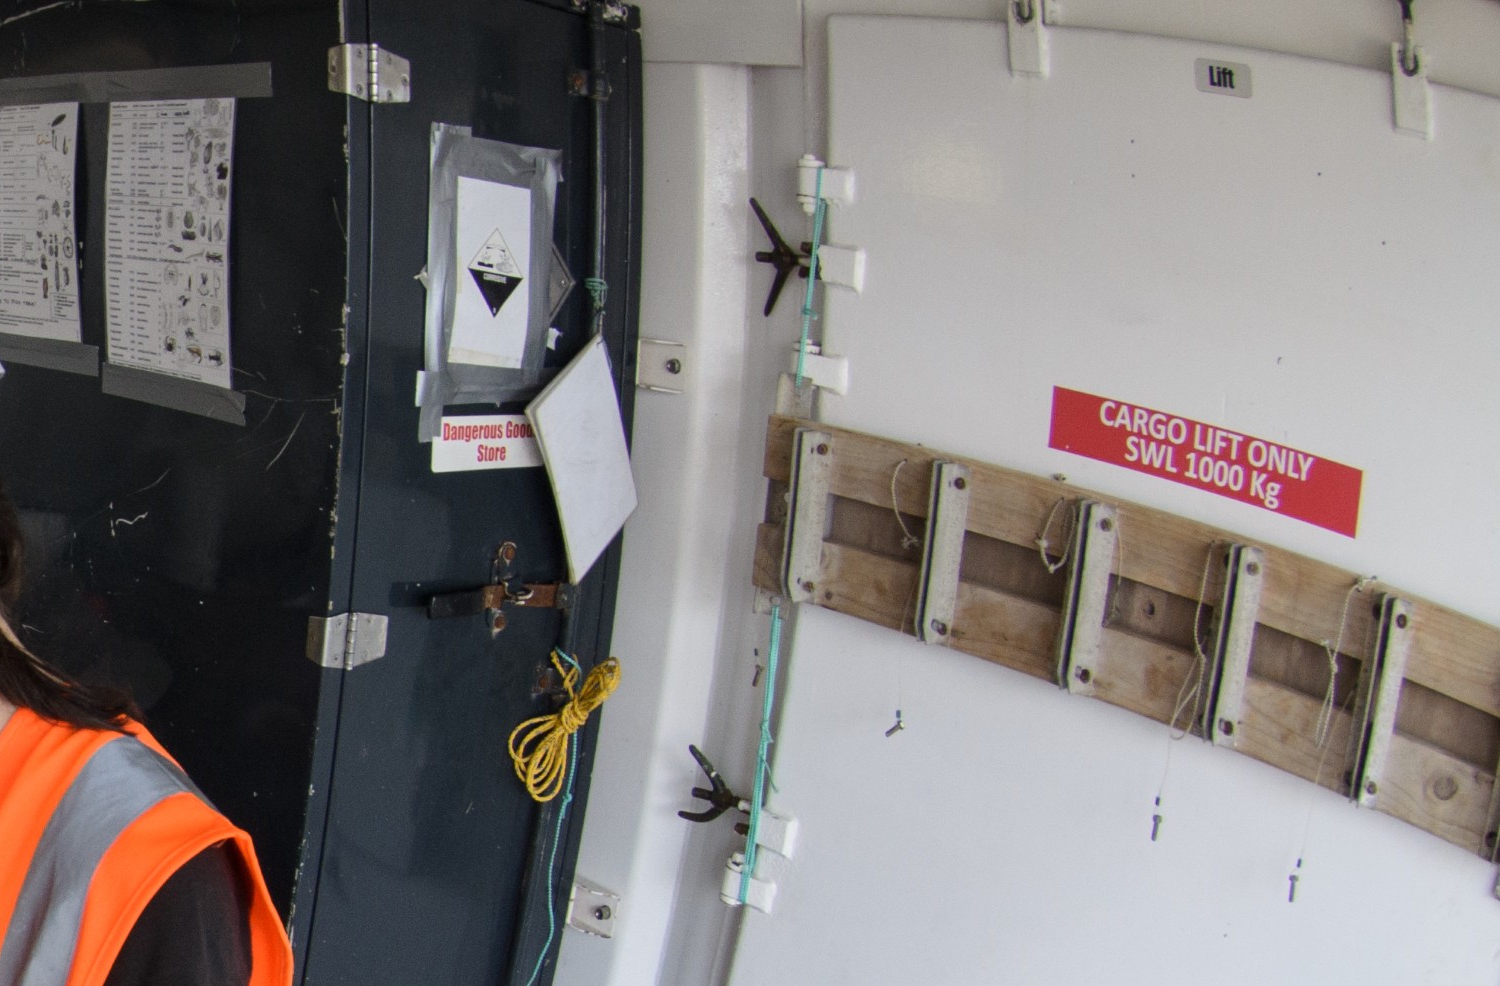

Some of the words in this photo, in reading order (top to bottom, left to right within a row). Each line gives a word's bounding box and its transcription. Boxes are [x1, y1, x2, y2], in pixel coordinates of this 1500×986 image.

[1208, 65, 1235, 89] Lift
[443, 422, 503, 442] Dangerous
[506, 420, 536, 438] Good
[1100, 401, 1187, 445] CARGO
[1193, 424, 1243, 460] LIFT
[1248, 440, 1314, 481] ONLY
[477, 444, 506, 462] Store
[1124, 435, 1177, 473] SWL
[1184, 452, 1244, 492] 1000
[1250, 470, 1281, 509] Kg
